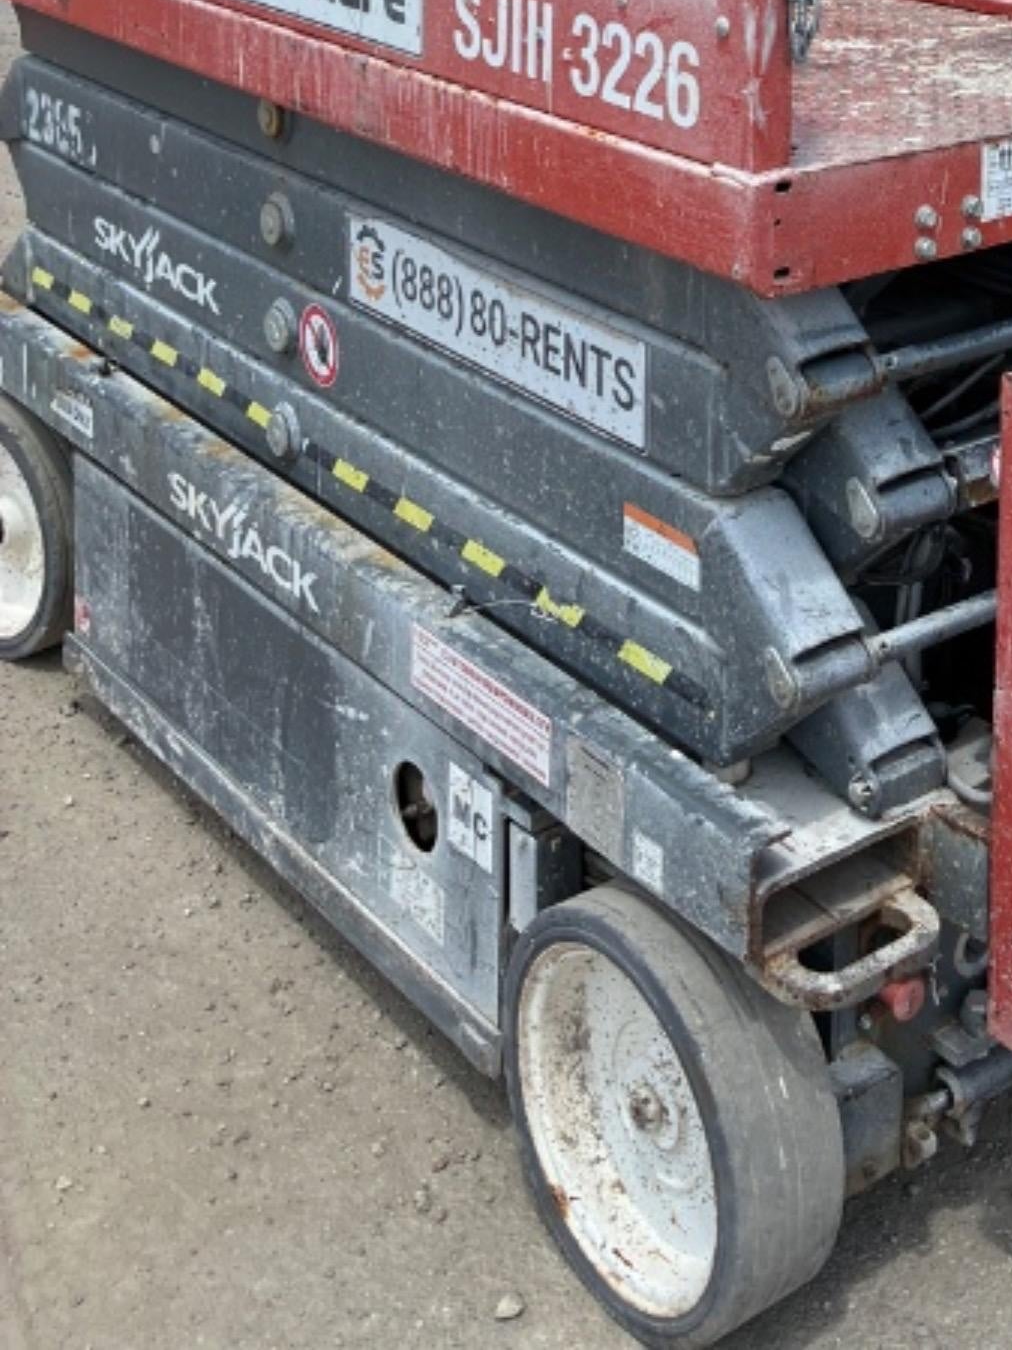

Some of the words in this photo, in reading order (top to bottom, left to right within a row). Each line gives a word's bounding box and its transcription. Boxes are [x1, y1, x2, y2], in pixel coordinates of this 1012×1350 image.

[569, 11, 700, 129] 3226
[93, 214, 221, 315] SKYJACK
[167, 473, 320, 613] SKYJACK
